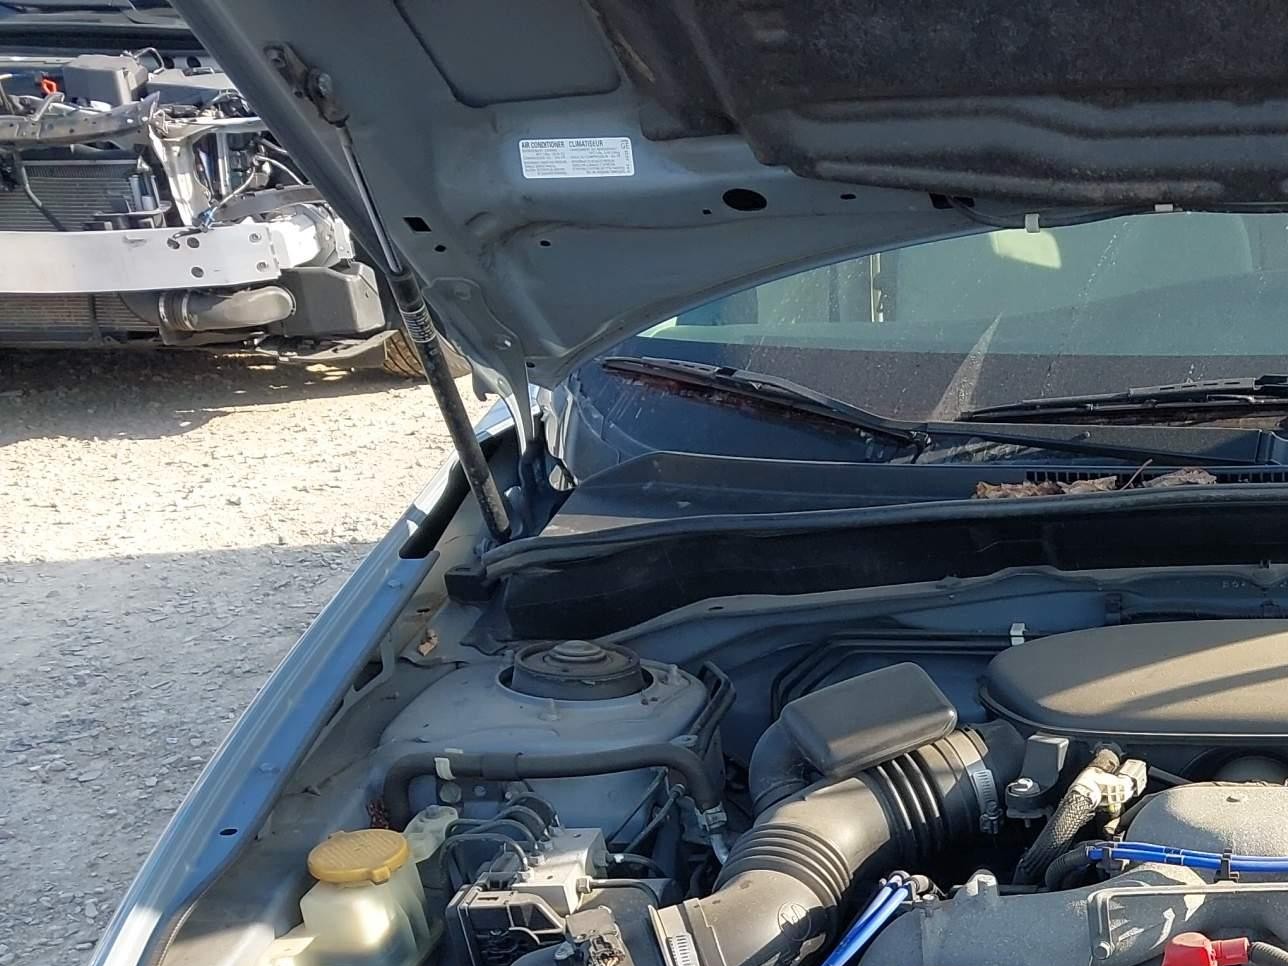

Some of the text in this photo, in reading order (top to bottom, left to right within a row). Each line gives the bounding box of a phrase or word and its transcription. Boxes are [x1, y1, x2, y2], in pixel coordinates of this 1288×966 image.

[521, 141, 565, 149] AIR CONDITIONER
[568, 139, 604, 149] CLIMATISEUR
